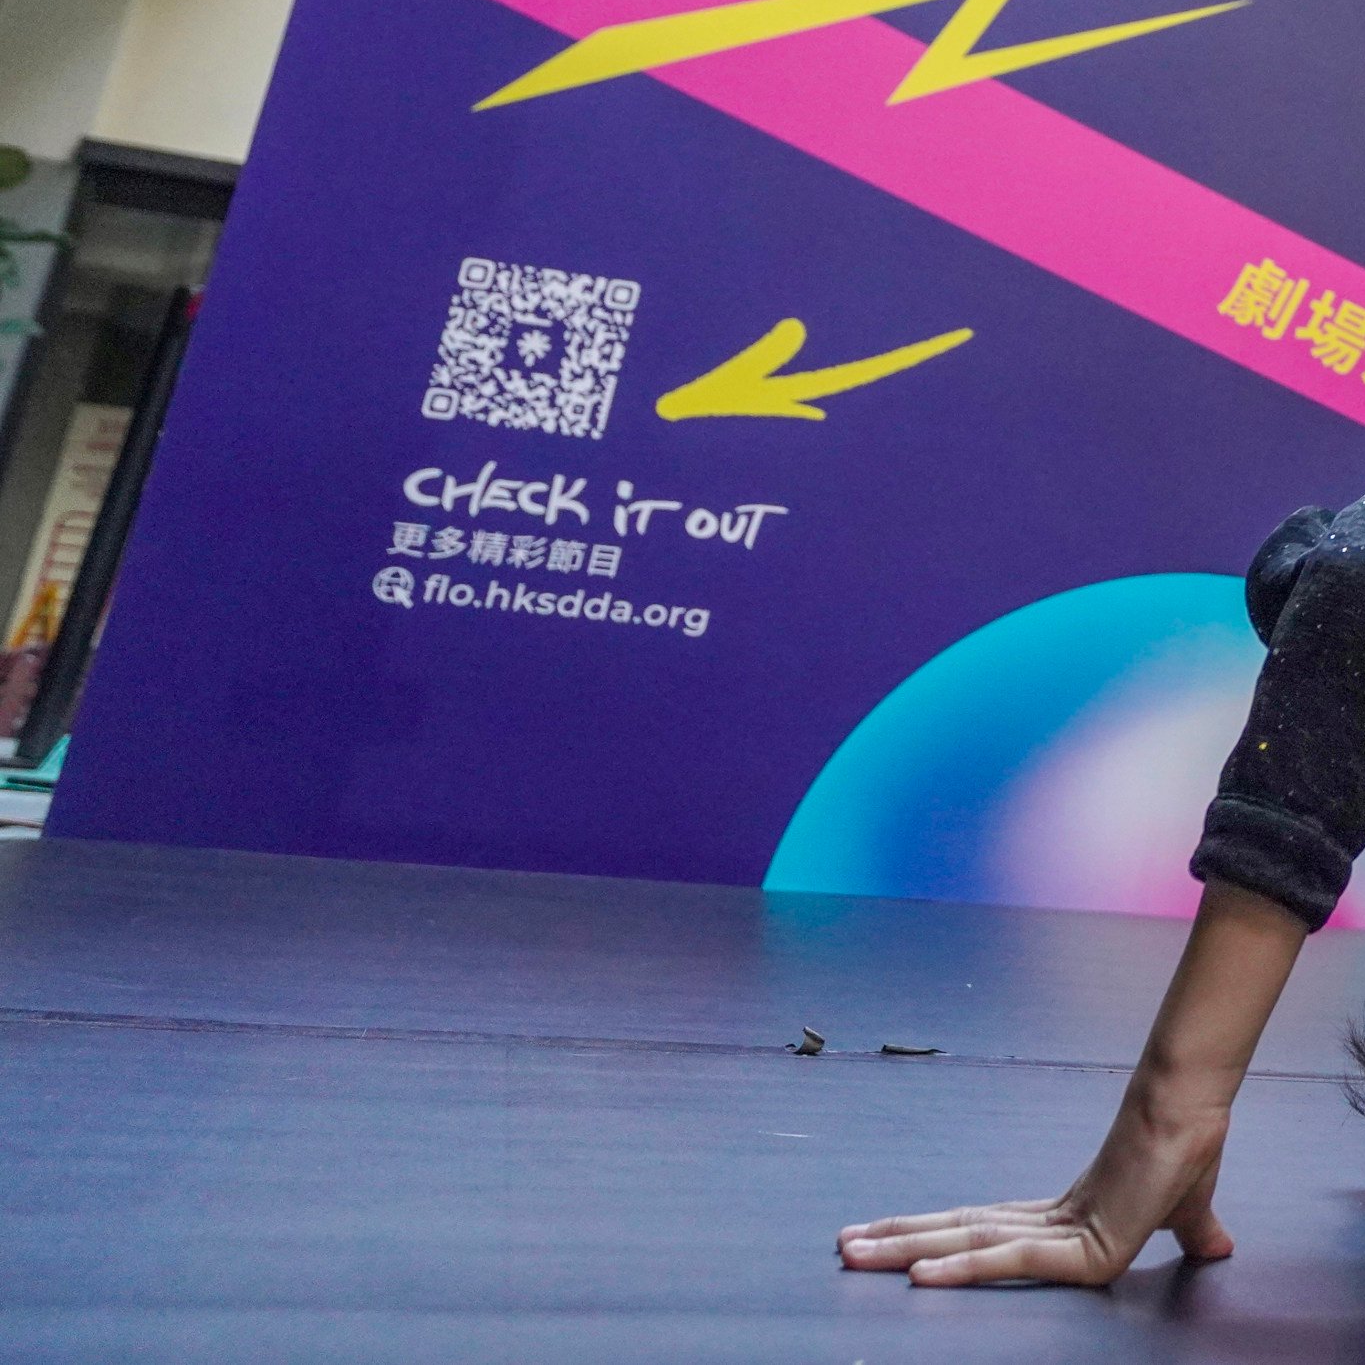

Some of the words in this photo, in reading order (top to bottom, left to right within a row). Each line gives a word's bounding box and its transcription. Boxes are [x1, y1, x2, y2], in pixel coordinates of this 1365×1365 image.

[403, 459, 590, 527] CHECK
[684, 504, 790, 551] OUT
[386, 520, 623, 580] 更多精彩節目
[422, 573, 711, 637] flo.hksdda.org
